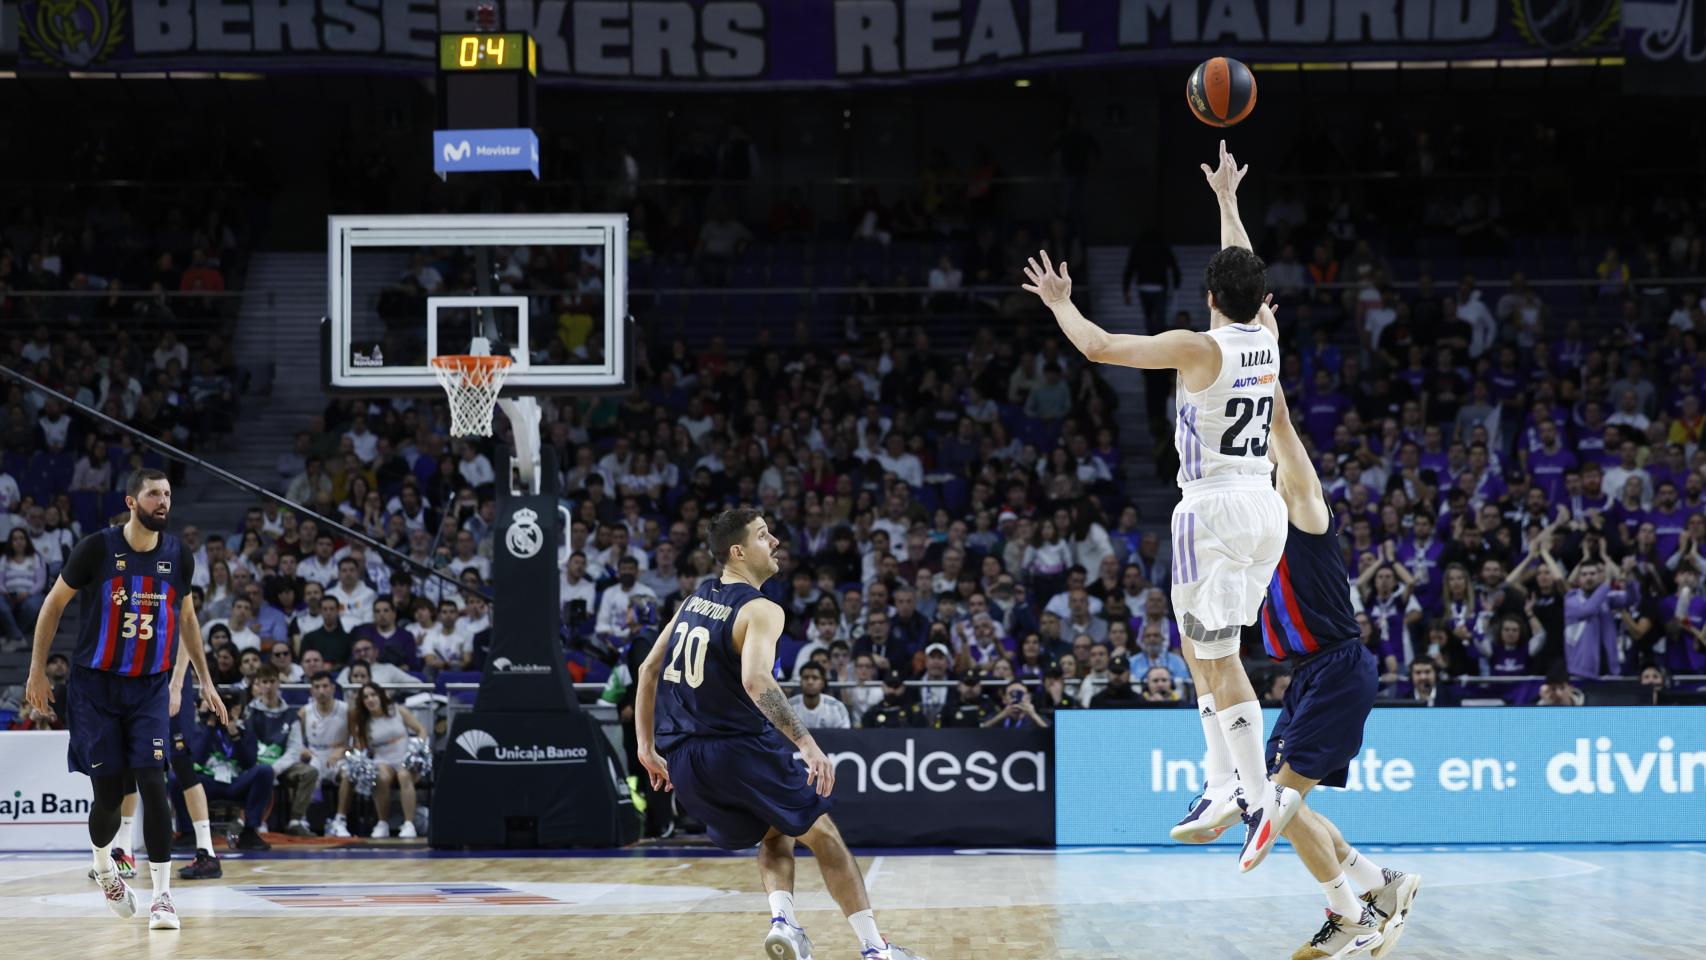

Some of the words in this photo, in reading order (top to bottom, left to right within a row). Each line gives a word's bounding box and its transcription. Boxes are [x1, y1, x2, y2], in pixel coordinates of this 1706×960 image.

[836, 0, 1083, 75] REAL
[1118, 0, 1497, 46] MADRID
[476, 145, 522, 156] Movistar
[1241, 349, 1274, 368] LLULL
[1220, 396, 1274, 456] 23
[122, 612, 154, 640] 33
[663, 621, 710, 689] 20
[495, 745, 545, 761] Unicaja
[547, 746, 587, 758] Banco
[793, 738, 1045, 793] ndesa
[1438, 757, 1517, 792] en:
[0, 790, 36, 820] aja
